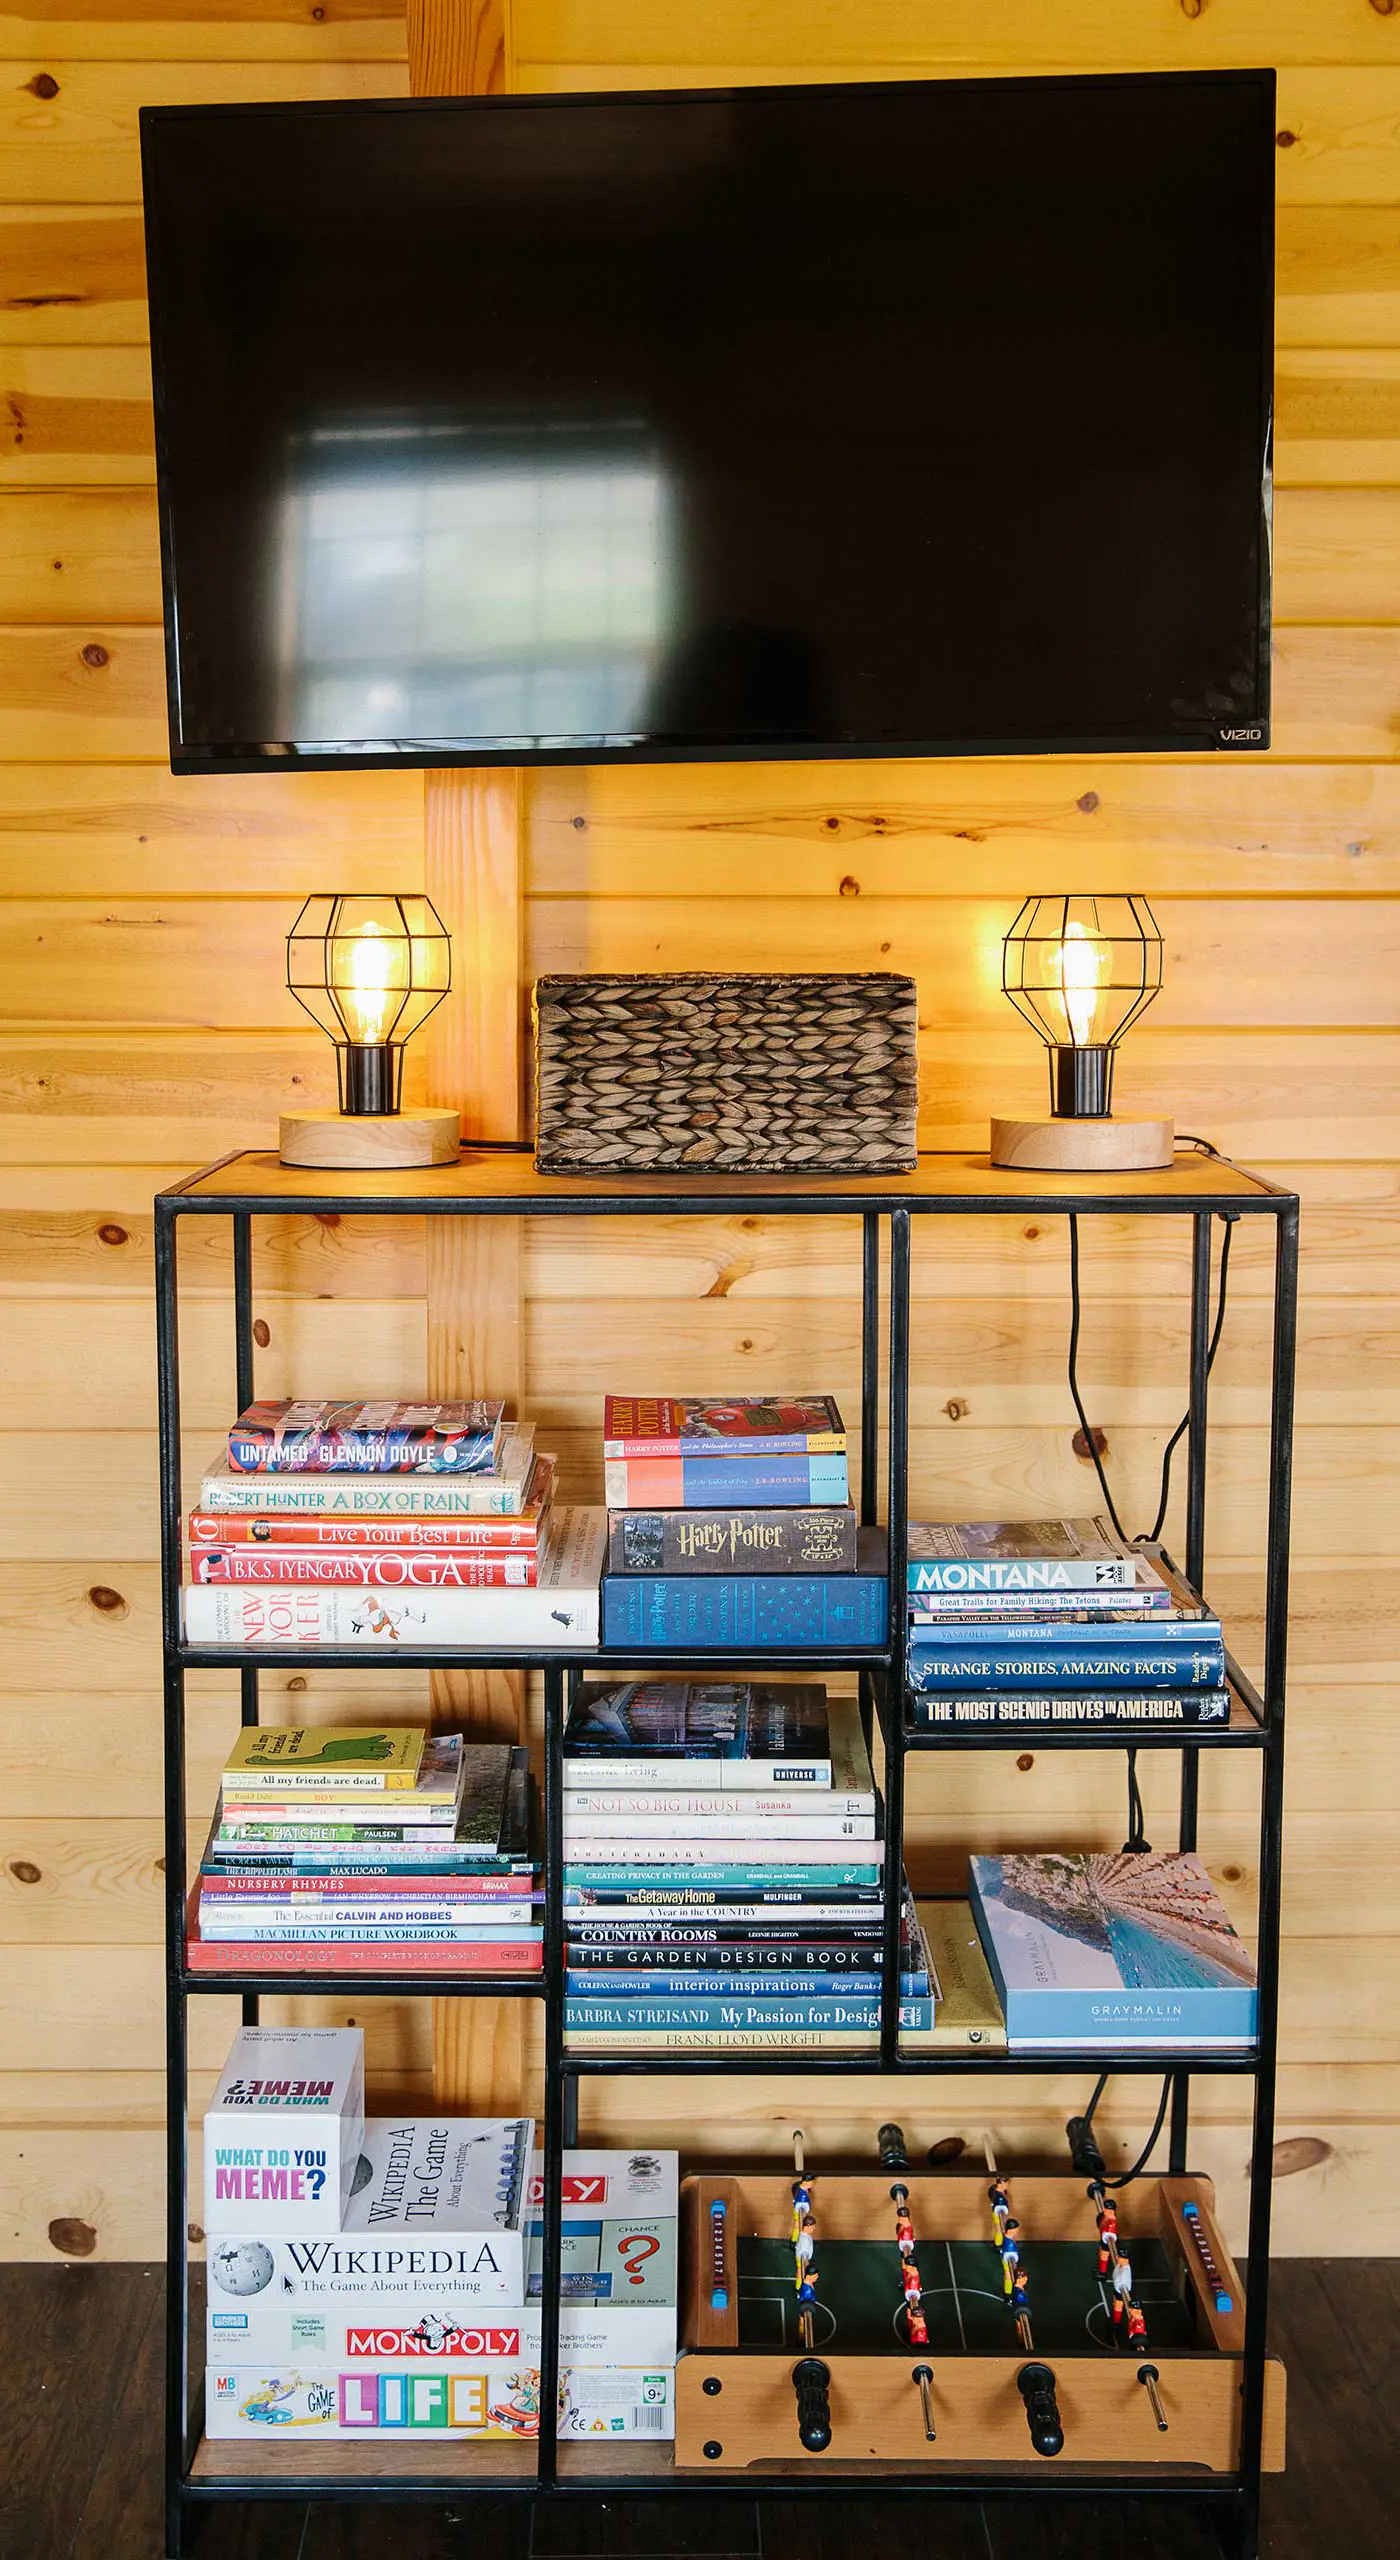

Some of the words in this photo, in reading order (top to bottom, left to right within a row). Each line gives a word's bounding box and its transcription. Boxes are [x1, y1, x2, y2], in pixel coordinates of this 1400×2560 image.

[1220, 729, 1262, 741] VIZIO
[612, 1399, 633, 1435] HARRY
[638, 1399, 659, 1435] POTTER
[240, 1445, 308, 1462] UNTAMED
[319, 1445, 386, 1463] GLENNON
[389, 1445, 436, 1463] DOYLE
[266, 1492, 325, 1507] HUNTER
[332, 1491, 350, 1509] A
[353, 1491, 391, 1510] BOX
[395, 1491, 420, 1511] OF
[424, 1492, 470, 1512] RAIN
[318, 1523, 358, 1542] Live
[362, 1525, 402, 1543] Your
[409, 1525, 448, 1545] Best
[455, 1525, 493, 1544] Life
[676, 1522, 729, 1557] Harry
[729, 1518, 784, 1564] Potter
[915, 1562, 1073, 1590] MONTANA
[939, 1598, 960, 1606] Great
[963, 1597, 984, 1606] Trails
[986, 1597, 998, 1606] for
[1000, 1597, 1025, 1607] Family
[1028, 1597, 1057, 1607] Hiking:
[1059, 1596, 1074, 1605] The
[1075, 1596, 1100, 1605] Tetons
[242, 1589, 265, 1641] NEW
[268, 1591, 293, 1641] YOR
[296, 1591, 320, 1641] KER
[1008, 1629, 1053, 1639] MONTANA
[923, 1662, 991, 1675] STRANGE
[995, 1662, 1059, 1676] STORIES,
[1061, 1662, 1131, 1675] AMAZING
[1134, 1661, 1177, 1675] FACTS
[1192, 1651, 1200, 1683] Reader's
[926, 1702, 953, 1721] THE
[955, 1701, 998, 1721] MOST
[999, 1701, 1050, 1721] SCENIC
[1051, 1700, 1104, 1719] DRIVES
[1105, 1700, 1117, 1714] IN
[1116, 1700, 1184, 1719] AMERICA
[261, 1775, 275, 1785] All
[277, 1777, 293, 1786] my
[295, 1775, 332, 1785] friends
[333, 1777, 351, 1785] are
[353, 1776, 382, 1786] dead.
[775, 1770, 814, 1779] UNIVERSE
[588, 1799, 622, 1811] NOT
[629, 1799, 649, 1811] SO
[654, 1799, 680, 1811] BIG
[687, 1799, 741, 1812] HOUSE
[755, 1800, 792, 1809] Susanka
[272, 1828, 338, 1839] HATCHET
[364, 1830, 397, 1838] PAULSEN
[330, 1867, 350, 1876] MAX
[351, 1866, 388, 1876] LUCADO
[586, 1872, 626, 1880] CREATING
[628, 1872, 661, 1880] PRIVACY
[663, 1872, 672, 1880] IN
[674, 1872, 690, 1880] THE
[692, 1872, 725, 1880] GARDEN
[227, 1879, 286, 1889] NURSERY
[292, 1879, 345, 1889] RHYMES
[482, 1882, 509, 1890] BRIMAX
[626, 1894, 639, 1903] The
[638, 1889, 684, 1905] Getaway
[684, 1888, 716, 1904] Home
[763, 1893, 802, 1901] MULFINGER
[273, 1910, 292, 1921] The
[294, 1910, 334, 1921] Essential
[335, 1911, 377, 1921] CALVIN
[379, 1911, 404, 1921] AND
[405, 1911, 452, 1921] HOBBES
[647, 1908, 654, 1917] A
[656, 1908, 677, 1917] Year
[679, 1908, 688, 1917] in
[690, 1908, 704, 1917] the
[706, 1908, 758, 1917] COUNTRY
[254, 1929, 326, 1939] MACMILLAN
[330, 1929, 381, 1939] PICTURE
[384, 1929, 458, 1939] WORDBOOK
[581, 1930, 657, 1942] COUNTRY
[660, 1930, 718, 1942] ROOMS
[216, 1949, 336, 1962] DRAGONOLOGY
[579, 1951, 615, 1962] THE
[627, 1951, 707, 1963] GARDEN
[720, 1951, 793, 1963] DESIGN
[806, 1952, 860, 1964] BOOK
[669, 1979, 726, 1991] interior
[730, 1978, 815, 1996] inspirations
[831, 1982, 853, 1992] Roger
[566, 2009, 622, 2023] BARBRA
[627, 2009, 710, 2024] STREISAND
[720, 2007, 743, 2028] My
[746, 2007, 804, 2023] Passion
[808, 2006, 830, 2023] for
[1091, 2005, 1182, 2015] GRAYMALIN
[666, 2034, 714, 2045] FRANK
[718, 2034, 763, 2045] LLOYD
[767, 2033, 826, 2045] WRIGHT
[226, 2080, 335, 2096] MEME?
[222, 2095, 254, 2105] YOU
[257, 2096, 279, 2105] DO
[283, 2096, 330, 2105] WHAT
[215, 2149, 264, 2167] WHAT
[267, 2149, 290, 2167] DO
[294, 2150, 327, 2167] YOU
[412, 2128, 449, 2181] Game
[449, 2142, 472, 2179] Everything
[367, 2126, 416, 2225] WIKIPEDIA
[215, 2168, 327, 2201] MEME?
[446, 2180, 463, 2209] About
[404, 2187, 440, 2223] The
[618, 2225, 660, 2233] CHANCE
[285, 2242, 503, 2274] WIKIPEDIA
[301, 2279, 327, 2292] The
[330, 2279, 367, 2292] Game
[370, 2279, 408, 2292] About
[413, 2279, 482, 2294] Everything
[350, 2331, 517, 2354] MONOPOLY
[311, 2382, 323, 2390] The
[308, 2390, 335, 2412] GAME
[345, 2379, 482, 2421] LIFE
[322, 2408, 332, 2419] of
